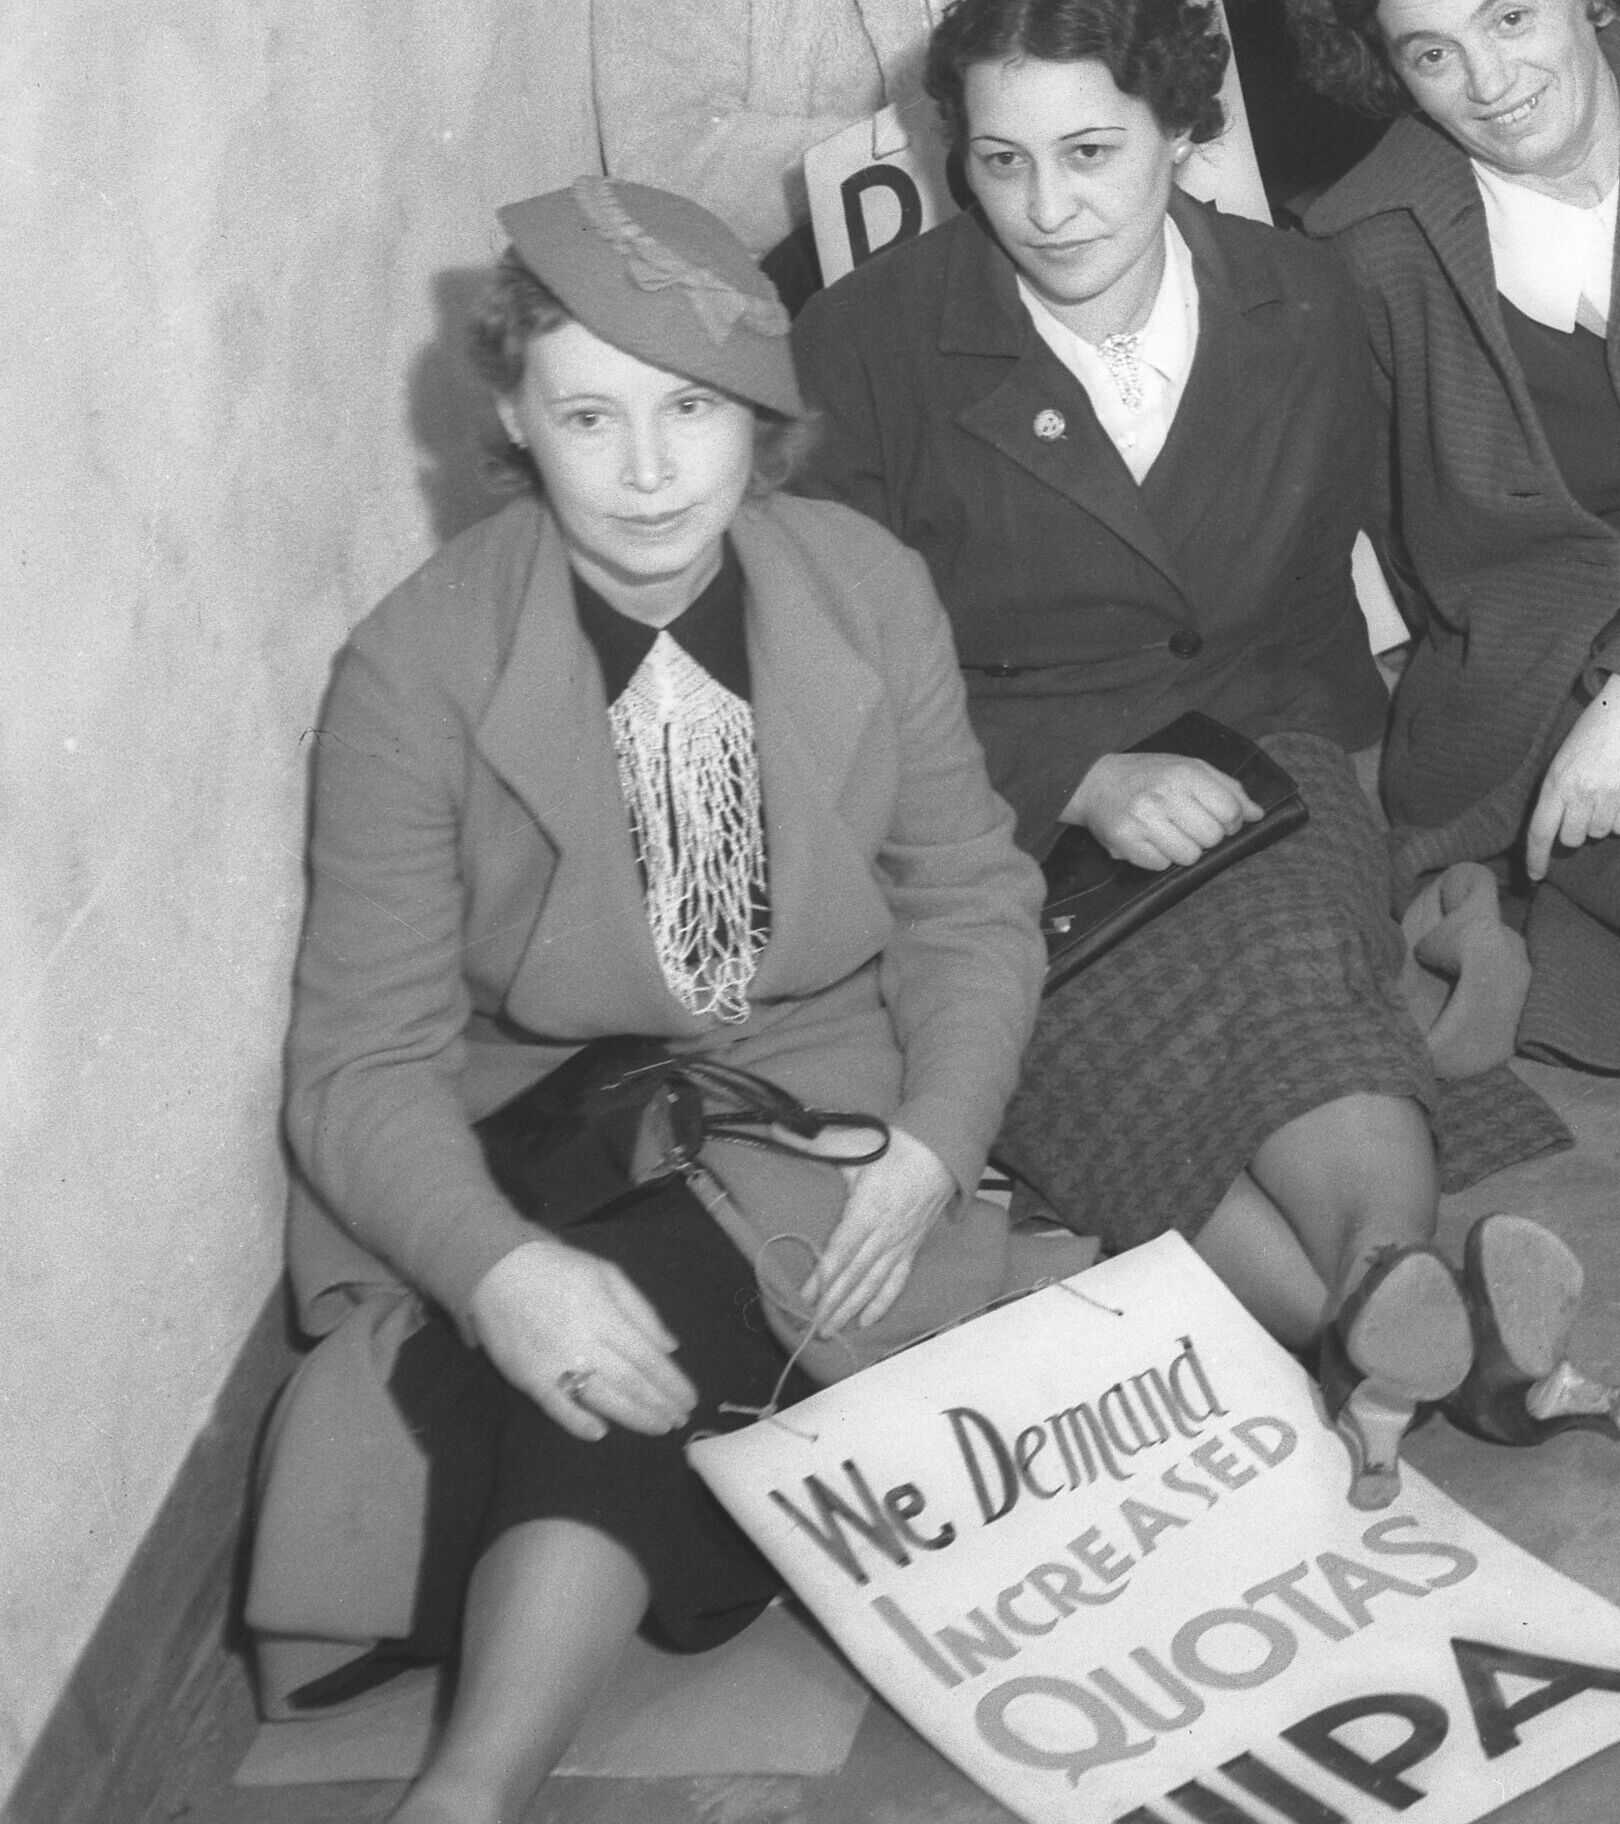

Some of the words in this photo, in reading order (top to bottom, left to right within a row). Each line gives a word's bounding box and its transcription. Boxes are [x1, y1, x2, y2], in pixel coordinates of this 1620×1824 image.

[768, 1459, 957, 1587] We
[939, 1334, 1231, 1528] Demand
[869, 1415, 1299, 1689] INCREASED
[974, 1514, 1480, 1788] QUOTAS
